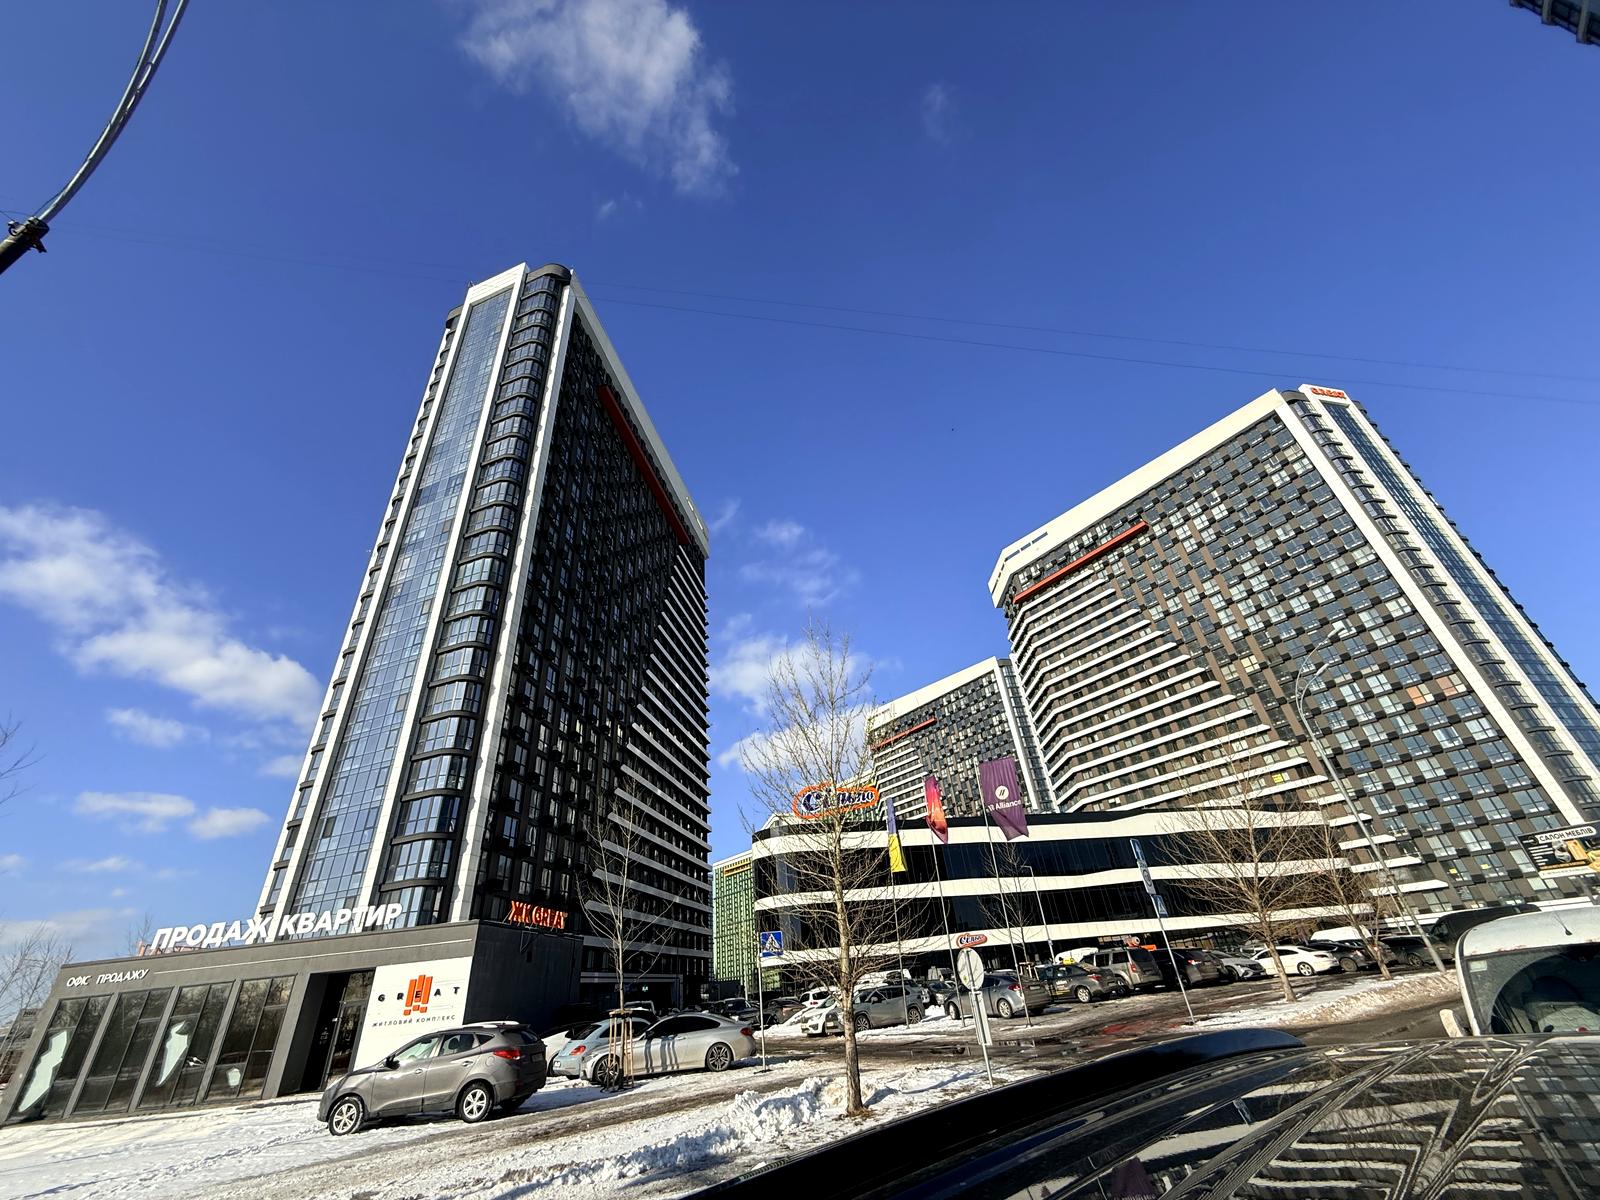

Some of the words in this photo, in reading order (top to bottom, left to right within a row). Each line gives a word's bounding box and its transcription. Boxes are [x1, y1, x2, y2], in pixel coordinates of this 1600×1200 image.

[995, 799, 1021, 811] Alliance
[1539, 832, 1565, 841] САЛОН
[508, 901, 531, 923] ЖК
[150, 916, 273, 950] ПРОДАЖ
[278, 903, 403, 936] КВАРТИР
[66, 975, 93, 987] ОФІС
[96, 969, 150, 985] ПРОДАЖУ
[372, 1018, 413, 1028] ЖИТЛОВИЙ
